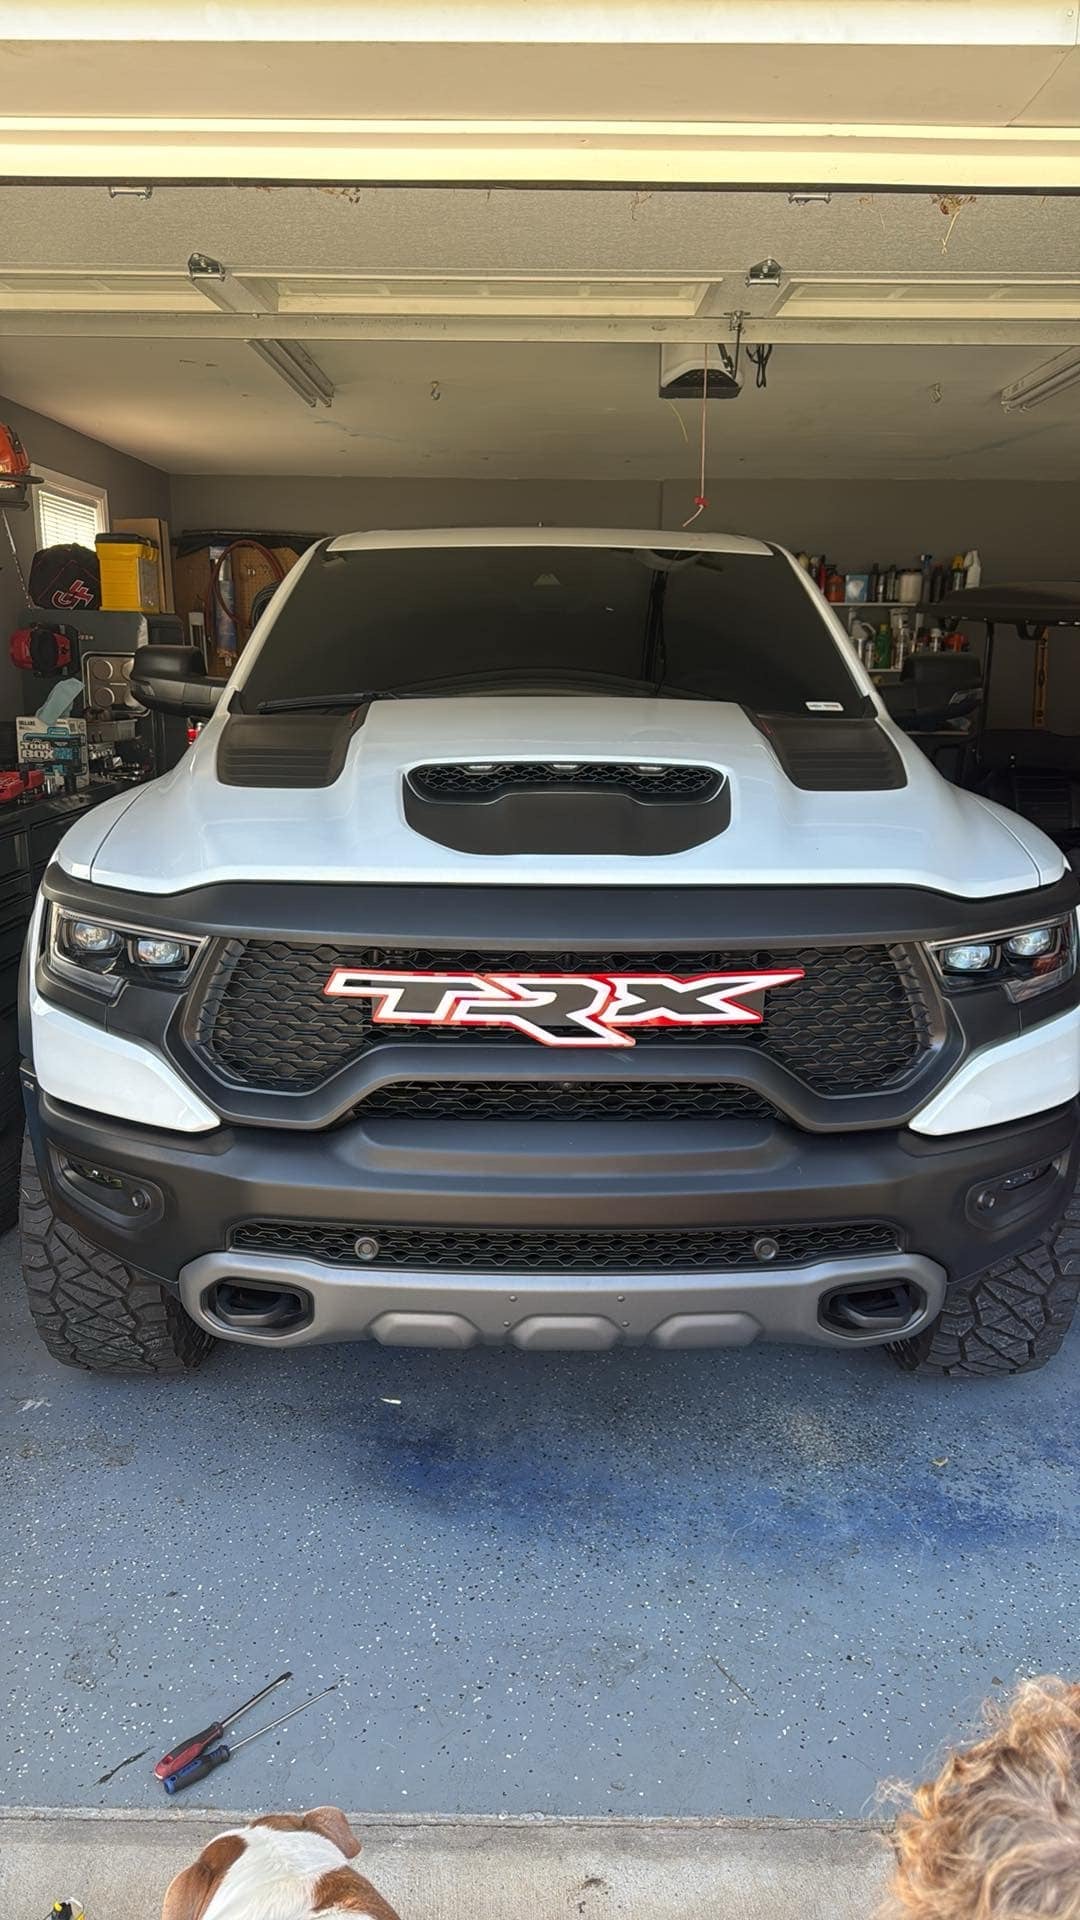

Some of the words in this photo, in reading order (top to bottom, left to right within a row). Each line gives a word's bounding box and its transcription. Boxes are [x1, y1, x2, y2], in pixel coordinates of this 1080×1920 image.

[20, 741, 53, 750] TOOL
[22, 749, 54, 760] BOX
[323, 969, 806, 1048] TRX
